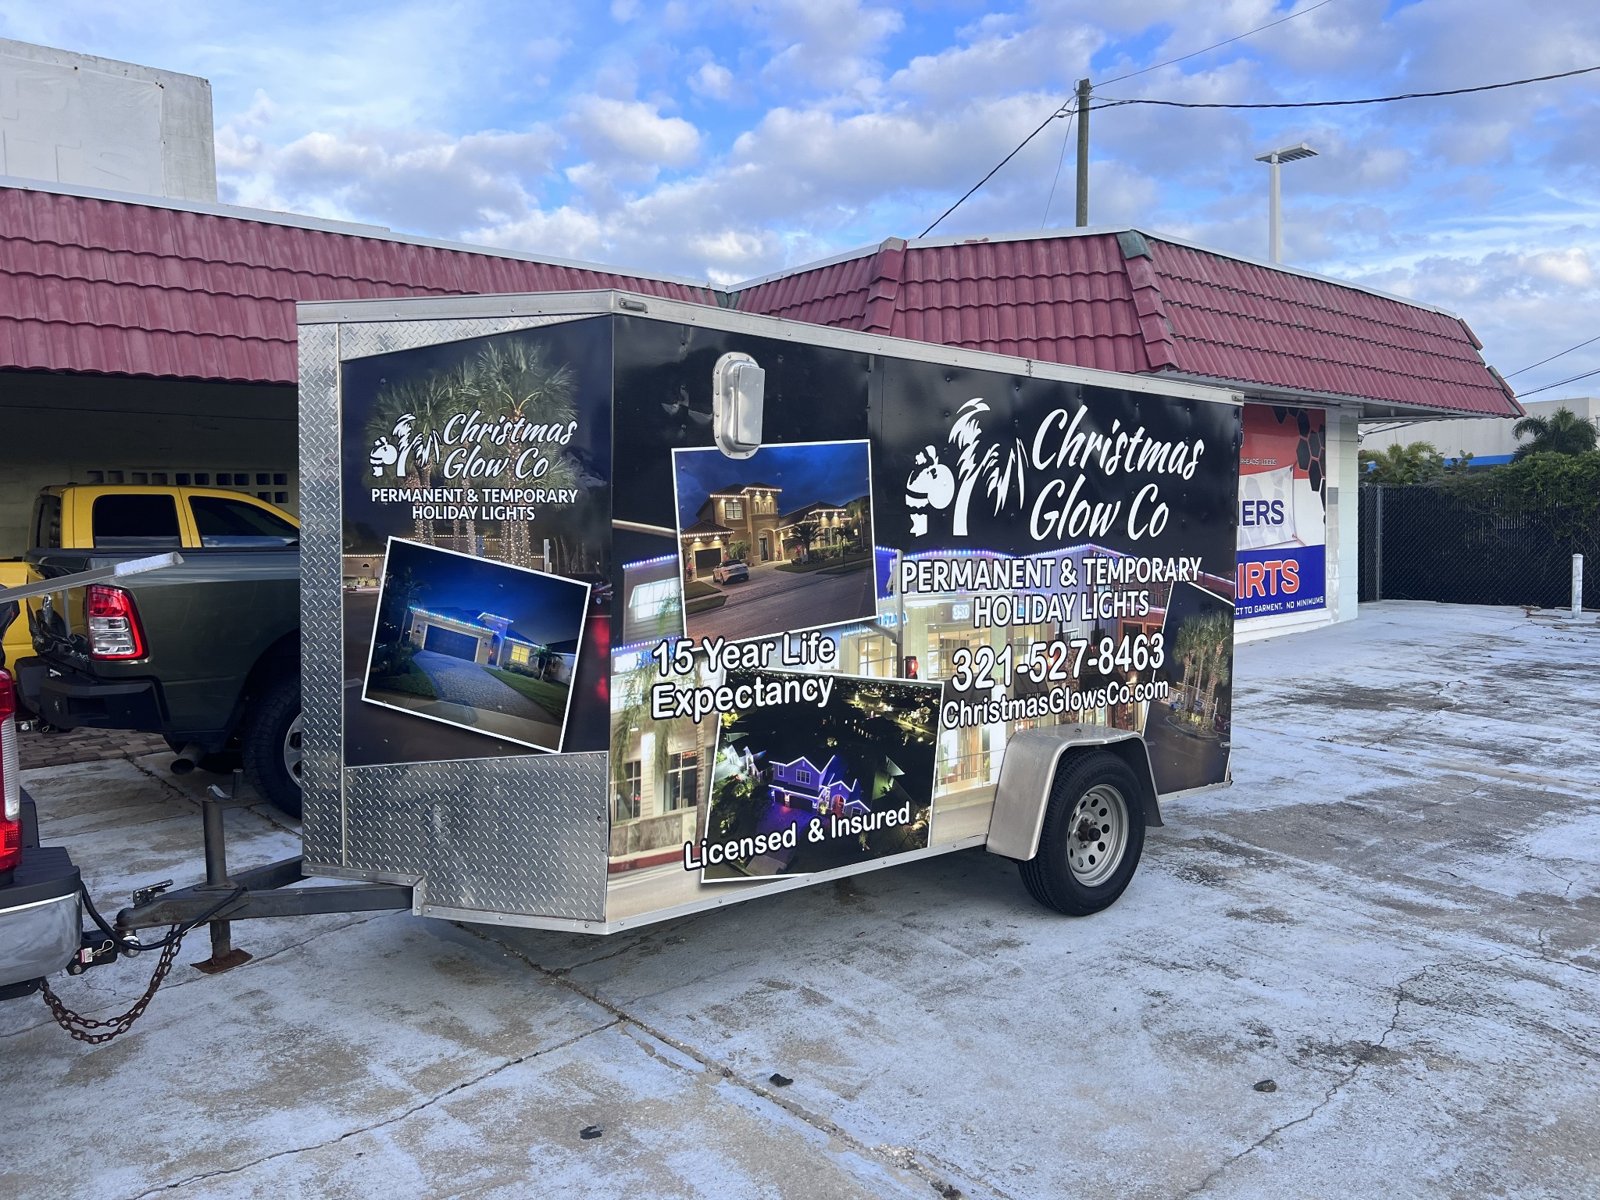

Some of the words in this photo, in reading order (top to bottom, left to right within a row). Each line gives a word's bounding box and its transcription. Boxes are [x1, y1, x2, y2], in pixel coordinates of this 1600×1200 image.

[443, 410, 578, 445] Christmas
[1031, 404, 1205, 480] Christmas
[443, 445, 510, 479] Glow
[515, 448, 549, 479] Co
[371, 488, 464, 503] PERMANENT
[466, 489, 479, 503] &
[482, 488, 578, 504] TEMPORARY
[412, 505, 479, 520] HOLIDAY
[482, 506, 535, 521] LIGHTS
[1029, 474, 1121, 541] Glow
[1127, 483, 1169, 541] Co
[1238, 499, 1285, 527] ERS
[901, 559, 1055, 593] PERMANENT
[1060, 559, 1079, 587] &
[1082, 557, 1202, 586] TEMPORARY
[1236, 559, 1300, 599] IRTS
[973, 593, 1077, 627] HOLIDAY
[1081, 590, 1149, 621] LIGHTS
[1245, 606, 1252, 614] TO
[1286, 601, 1295, 609] NO
[1296, 595, 1324, 608] MINIMUMS
[652, 640, 694, 676] 15
[702, 636, 774, 671] Year
[782, 632, 836, 665] Life
[951, 632, 1165, 692] 321-527-8463
[652, 676, 834, 722] Expectancy
[942, 680, 1169, 729] ChristmasGlowsCo.com
[684, 823, 797, 870] Licensed
[808, 818, 825, 842] &
[831, 801, 910, 839] Insured
